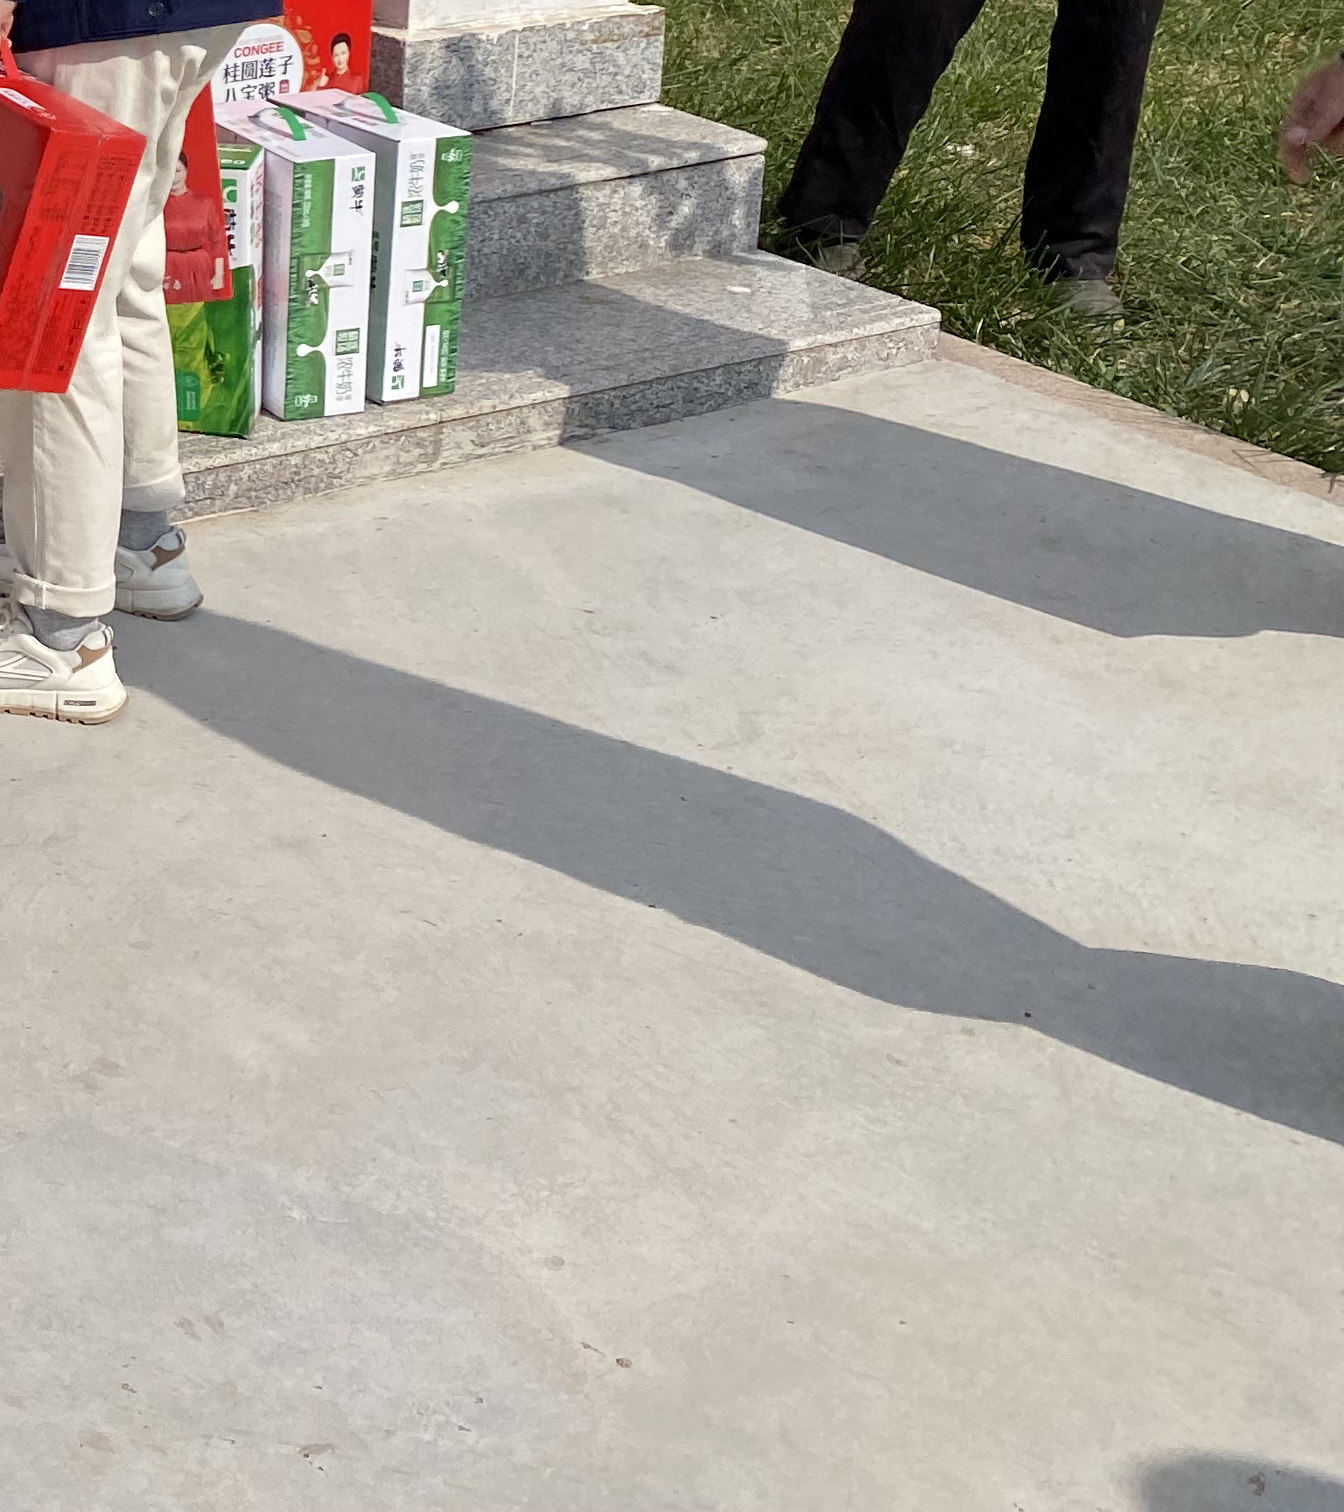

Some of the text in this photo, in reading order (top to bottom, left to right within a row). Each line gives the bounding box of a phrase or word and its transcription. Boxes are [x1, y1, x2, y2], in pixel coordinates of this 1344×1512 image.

[233, 41, 284, 59] CONGEE
[223, 54, 294, 84] 桂圆莲子
